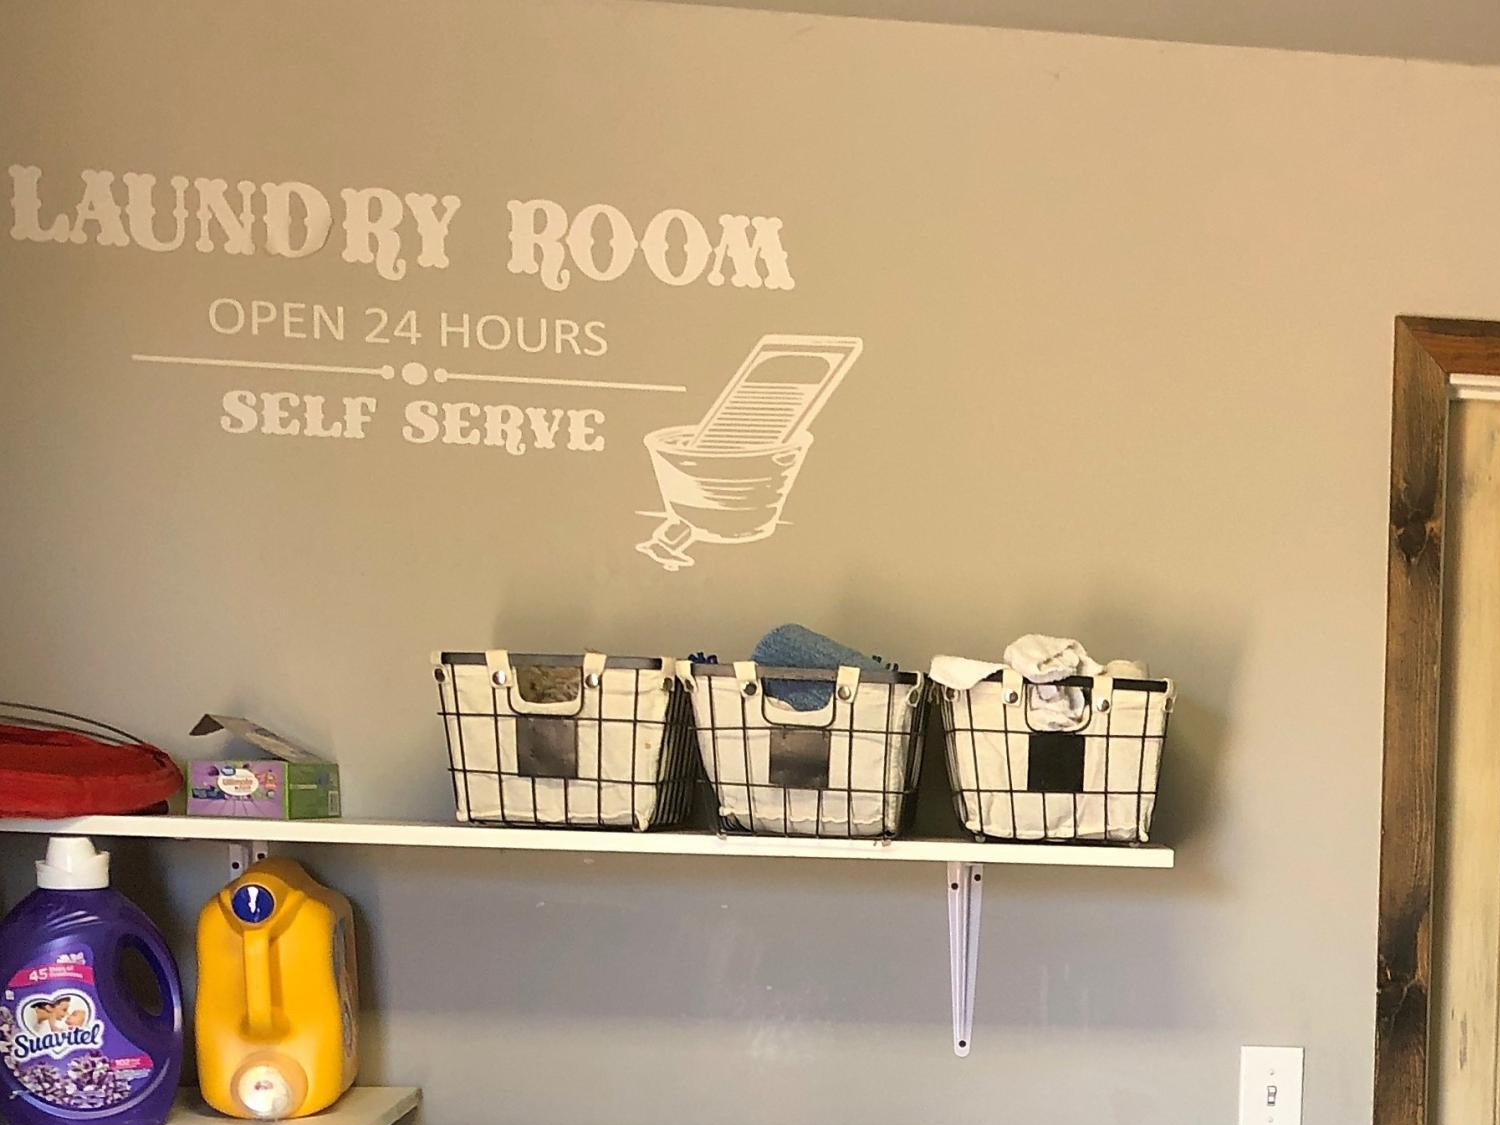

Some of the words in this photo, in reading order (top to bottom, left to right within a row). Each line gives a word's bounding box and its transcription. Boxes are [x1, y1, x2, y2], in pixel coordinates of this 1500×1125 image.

[9, 165, 461, 280] LAUNDRY
[507, 199, 796, 291] ROOM
[208, 297, 345, 341] OPEN
[365, 308, 422, 346] 24
[440, 312, 609, 357] HOURS
[220, 390, 377, 439] SELF
[403, 401, 606, 456] SERVE
[28, 967, 48, 981] 45
[14, 1023, 100, 1059] Suavitel
